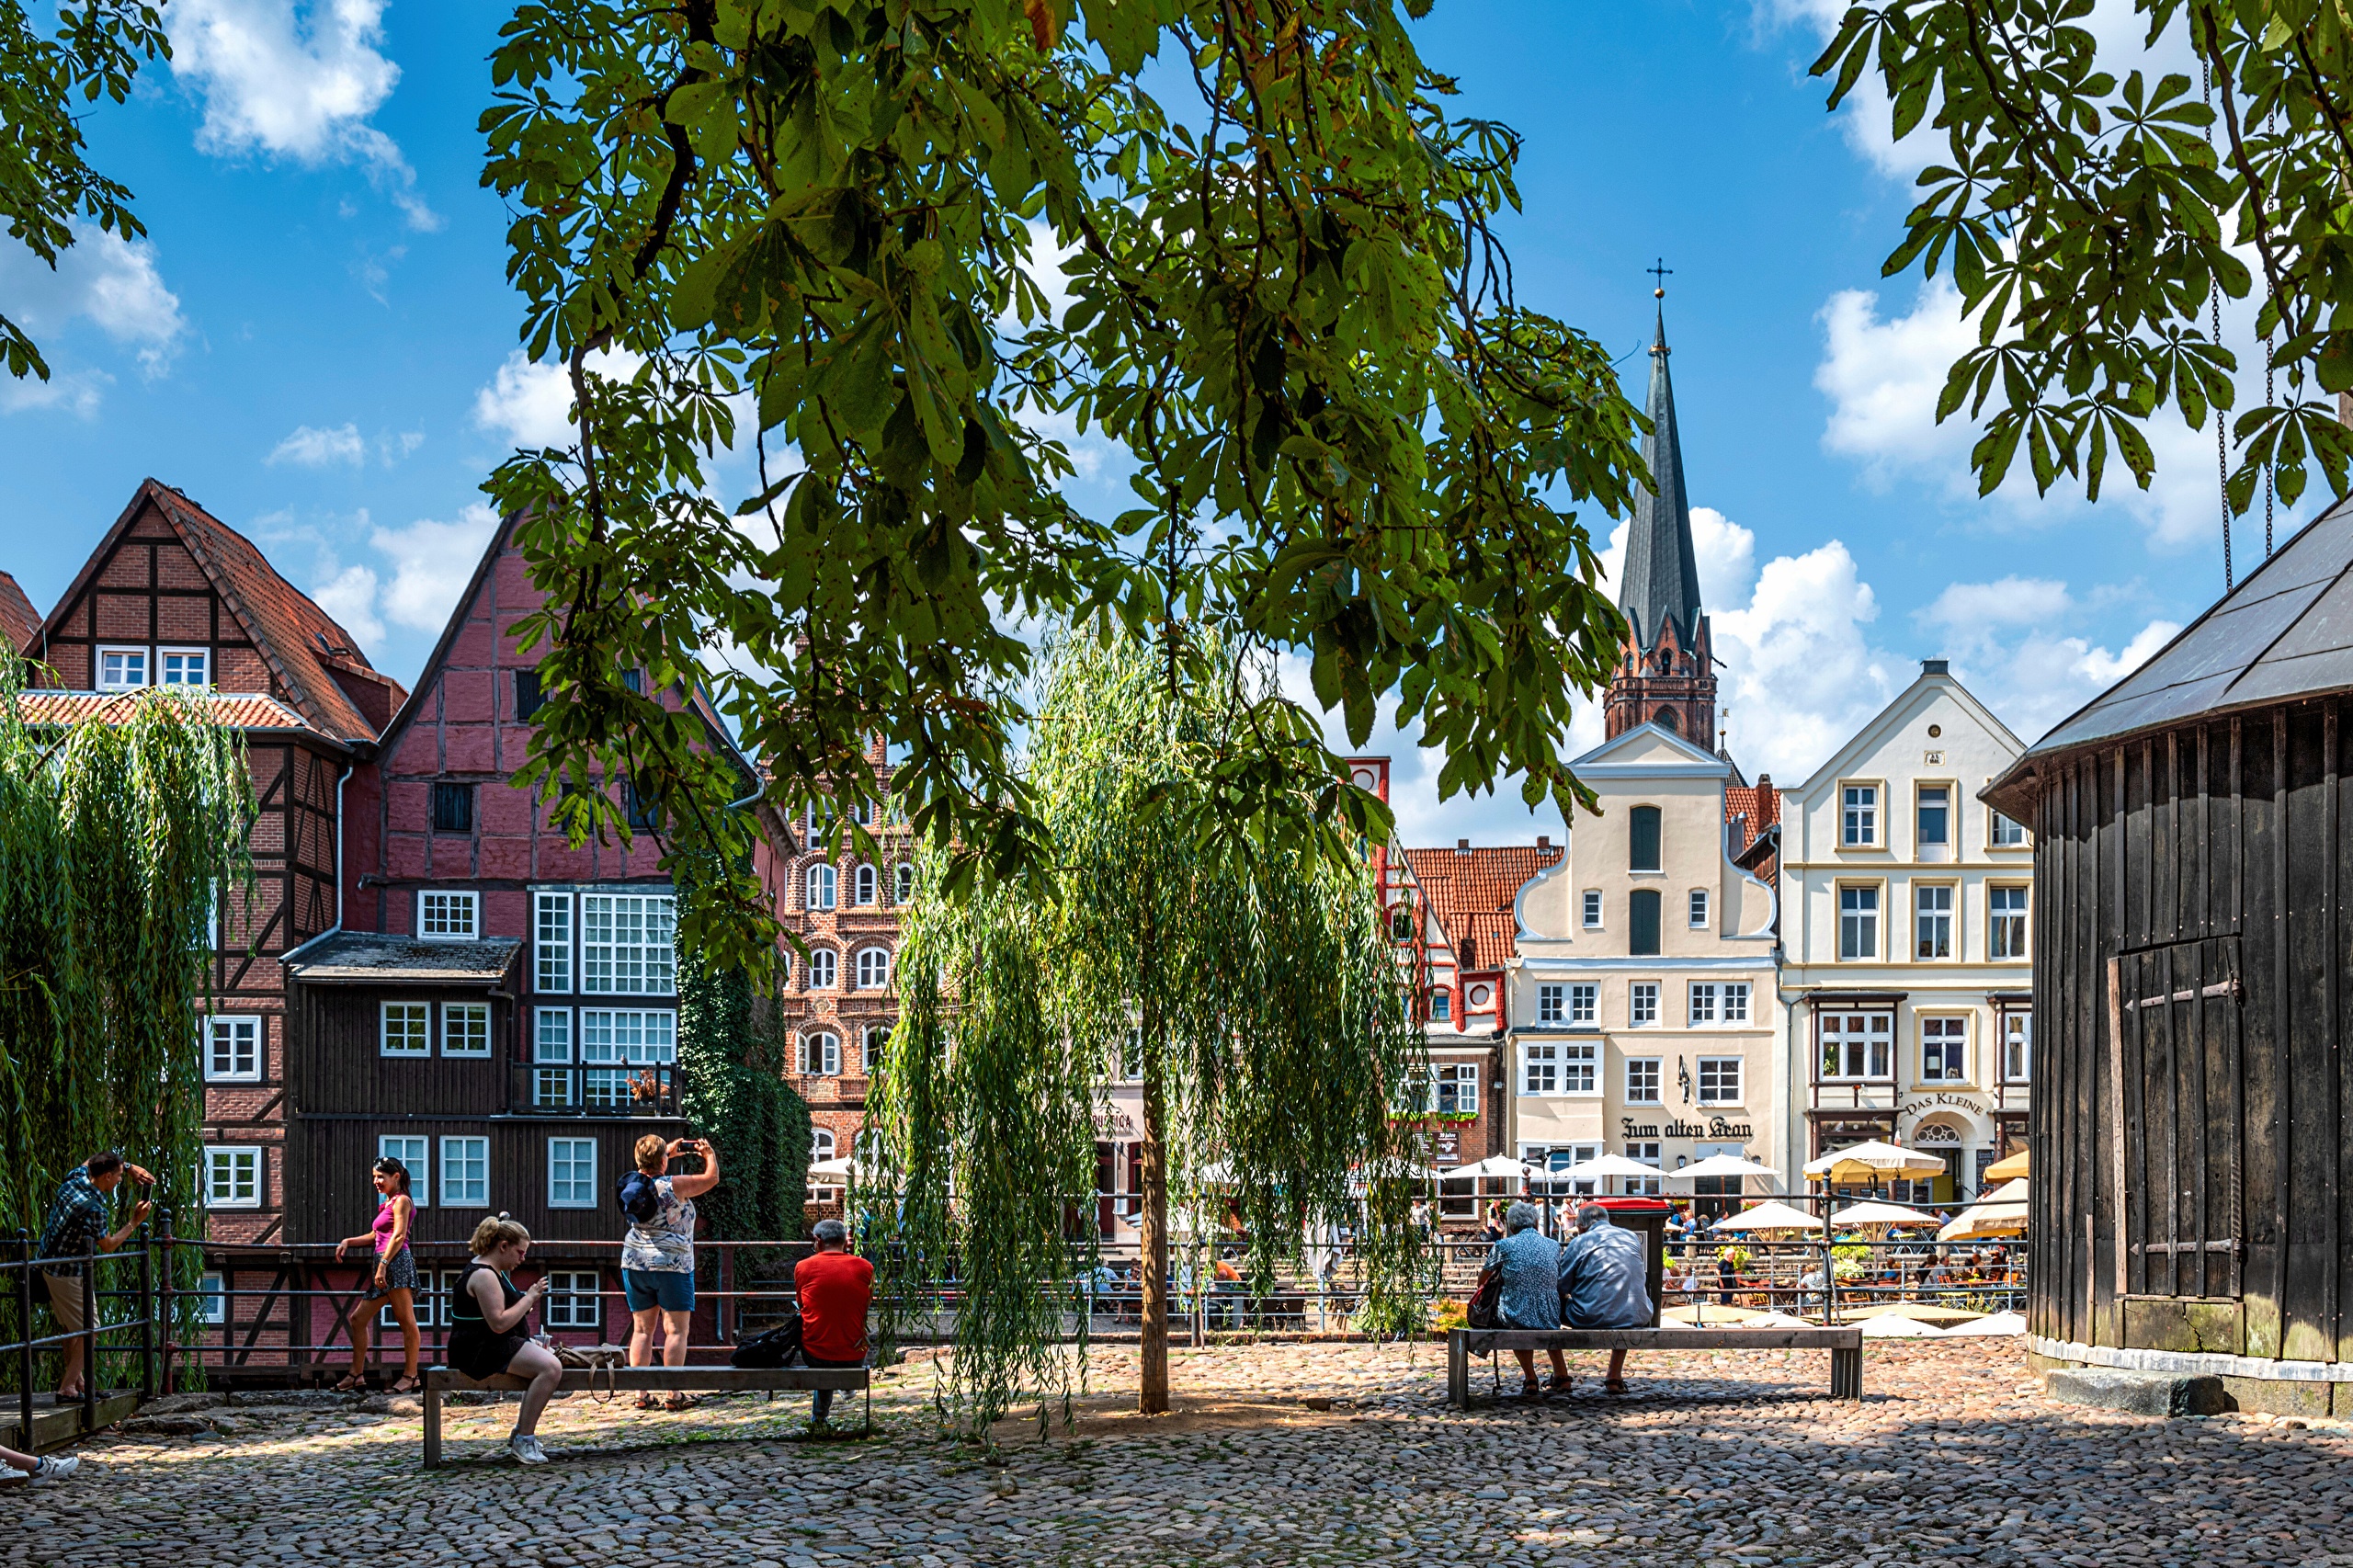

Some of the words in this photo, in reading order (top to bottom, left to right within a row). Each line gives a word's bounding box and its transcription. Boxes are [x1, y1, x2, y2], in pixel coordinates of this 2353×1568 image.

[1905, 1097, 1932, 1115] DAS
[1937, 1092, 1984, 1116] KLEINE
[1621, 1117, 1659, 1139] Zum
[1665, 1119, 1704, 1138] alten
[1708, 1116, 1753, 1138] Kran
